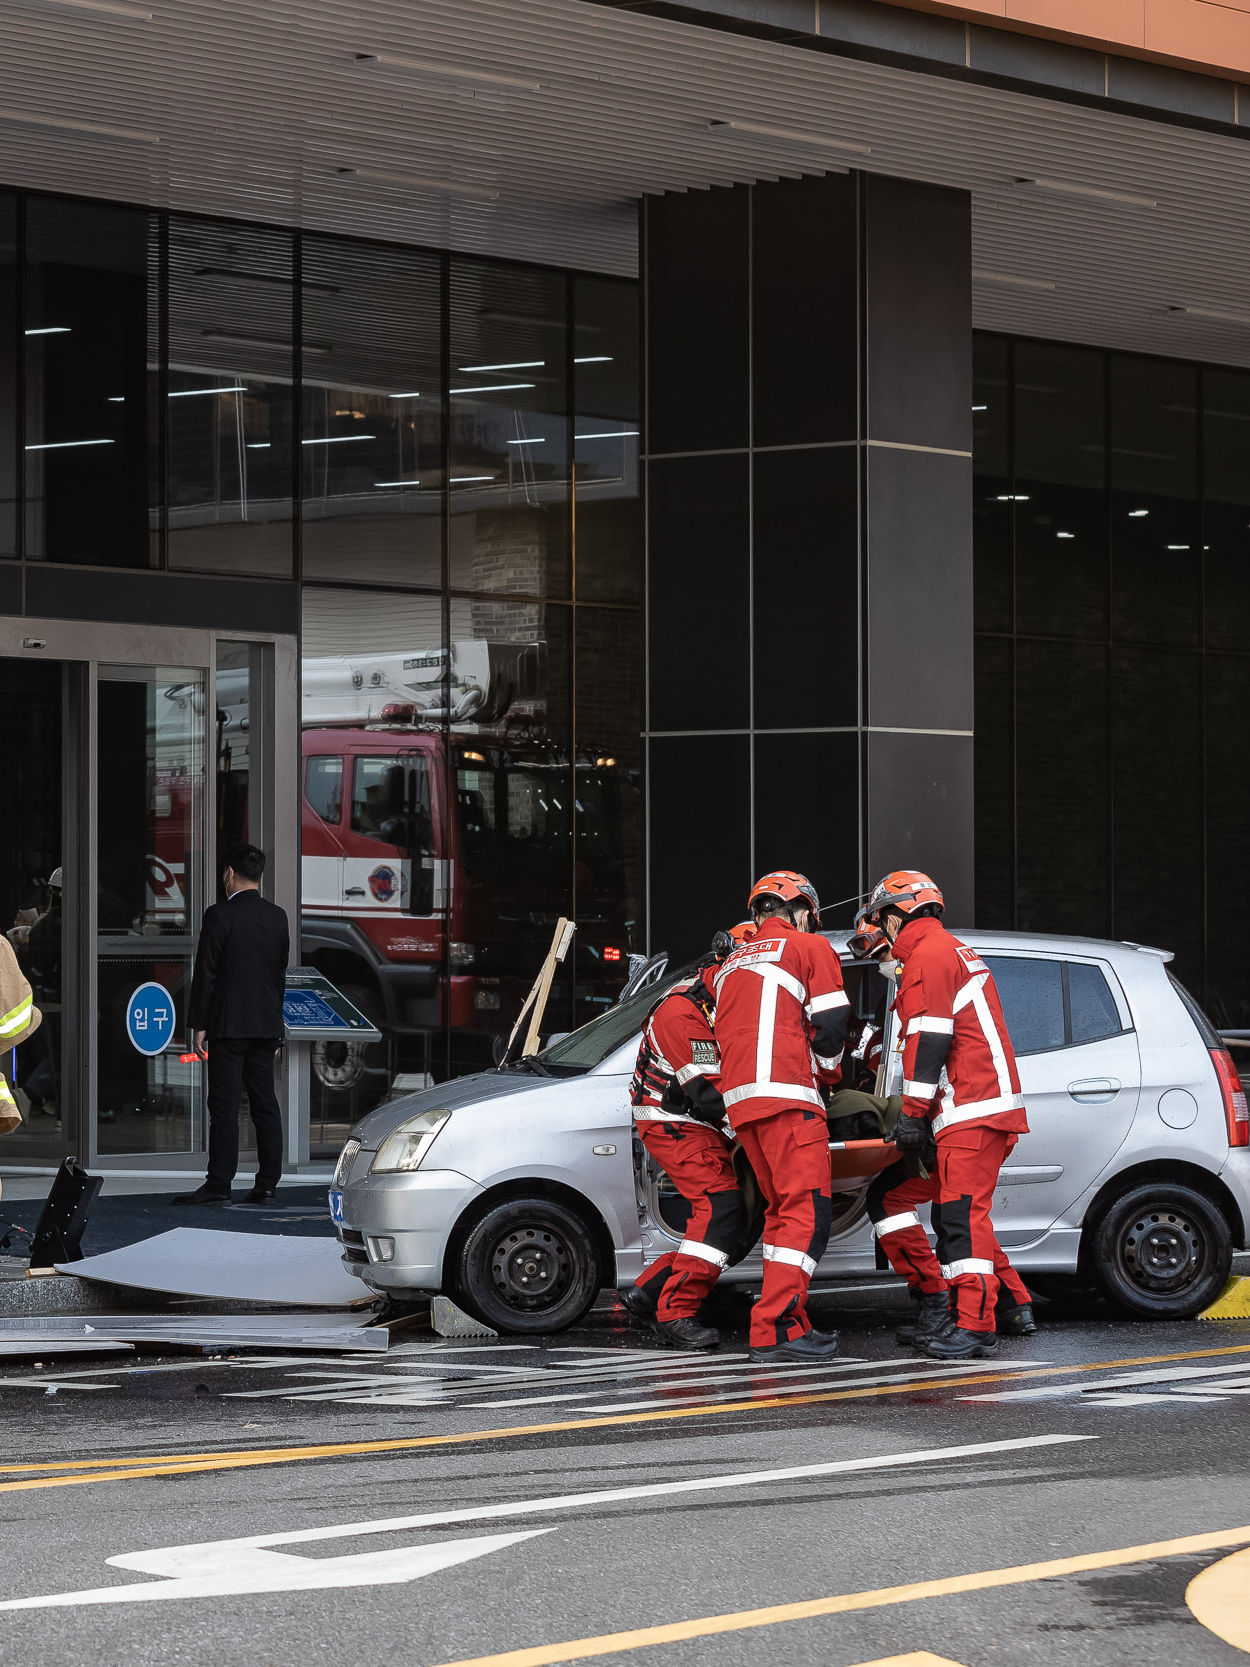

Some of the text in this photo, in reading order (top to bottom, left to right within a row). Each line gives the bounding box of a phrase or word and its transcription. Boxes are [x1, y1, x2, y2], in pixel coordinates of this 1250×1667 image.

[134, 1007, 169, 1030] 입구
[692, 1042, 713, 1050] FIRE
[694, 1053, 715, 1062] RESCUE
